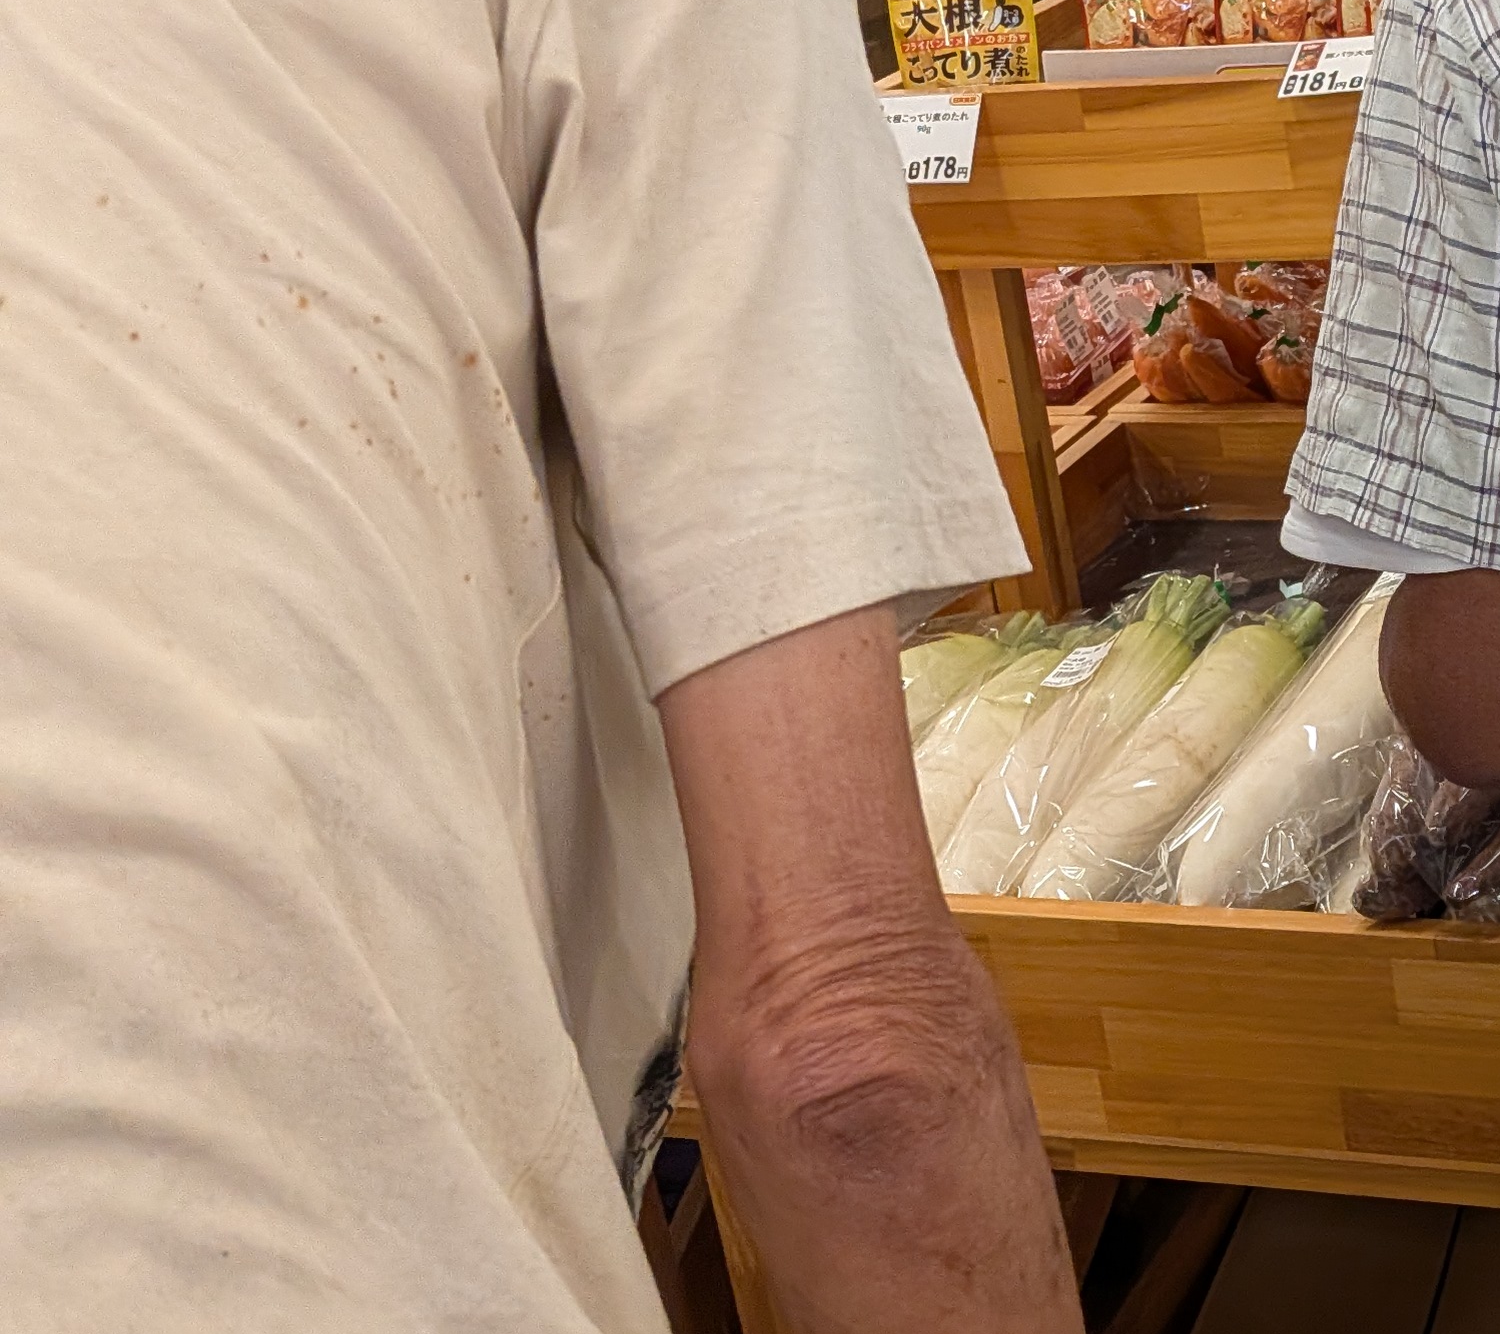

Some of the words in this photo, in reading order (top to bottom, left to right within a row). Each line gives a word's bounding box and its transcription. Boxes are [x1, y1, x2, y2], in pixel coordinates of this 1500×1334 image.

[906, 47, 1016, 84] こってり煮
[1015, 45, 1031, 78] のたれ
